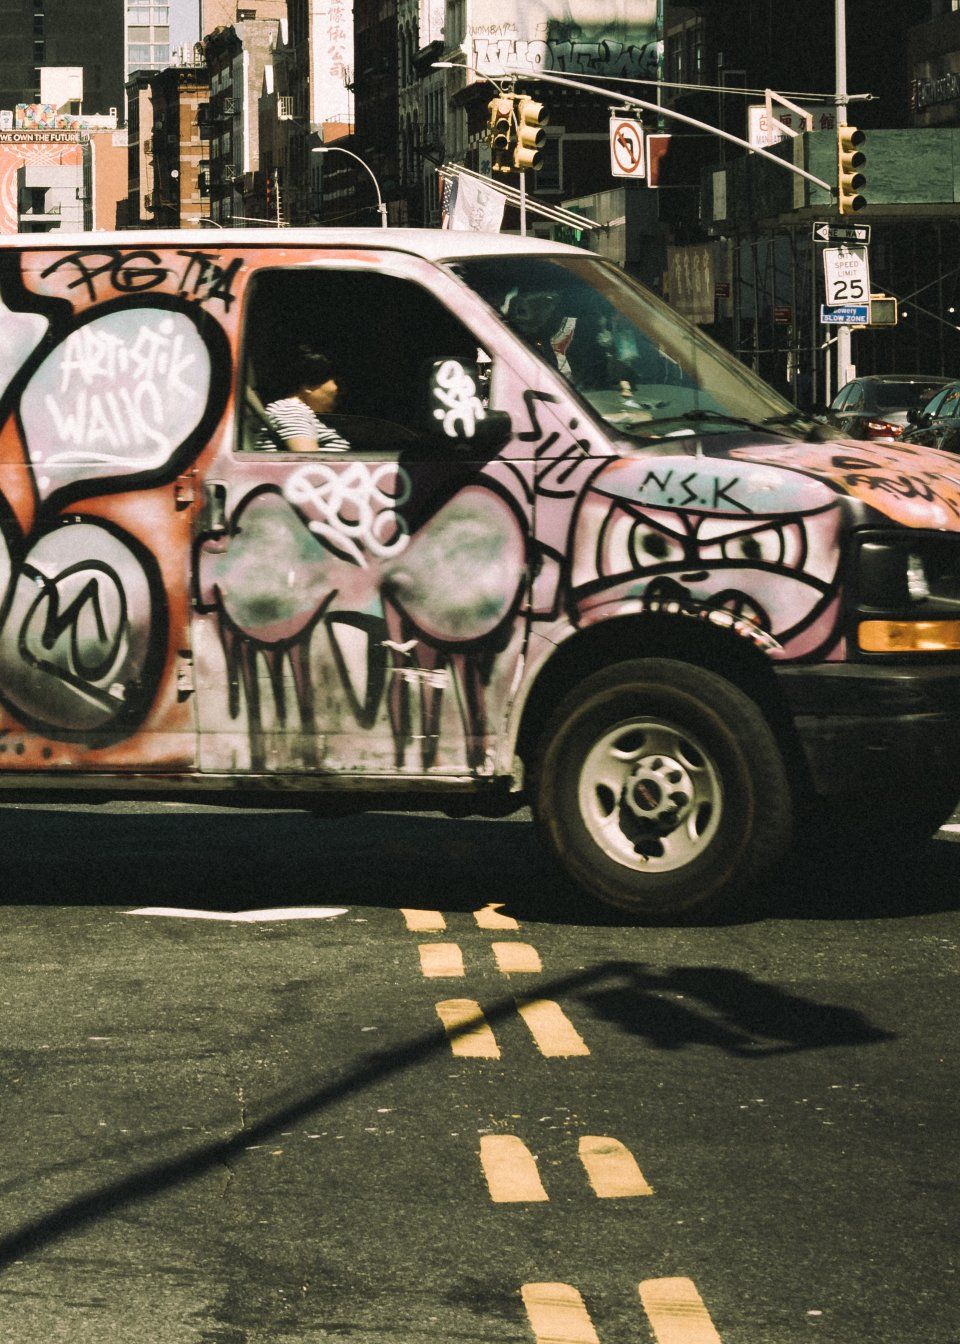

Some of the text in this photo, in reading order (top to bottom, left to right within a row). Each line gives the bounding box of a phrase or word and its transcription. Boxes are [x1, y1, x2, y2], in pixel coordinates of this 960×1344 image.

[0, 134, 80, 142] WE OWN THE FUTURE
[822, 229, 863, 237] ONE WAY
[835, 260, 859, 269] SPEED
[837, 269, 857, 278] LIMIT
[833, 279, 864, 301] 25
